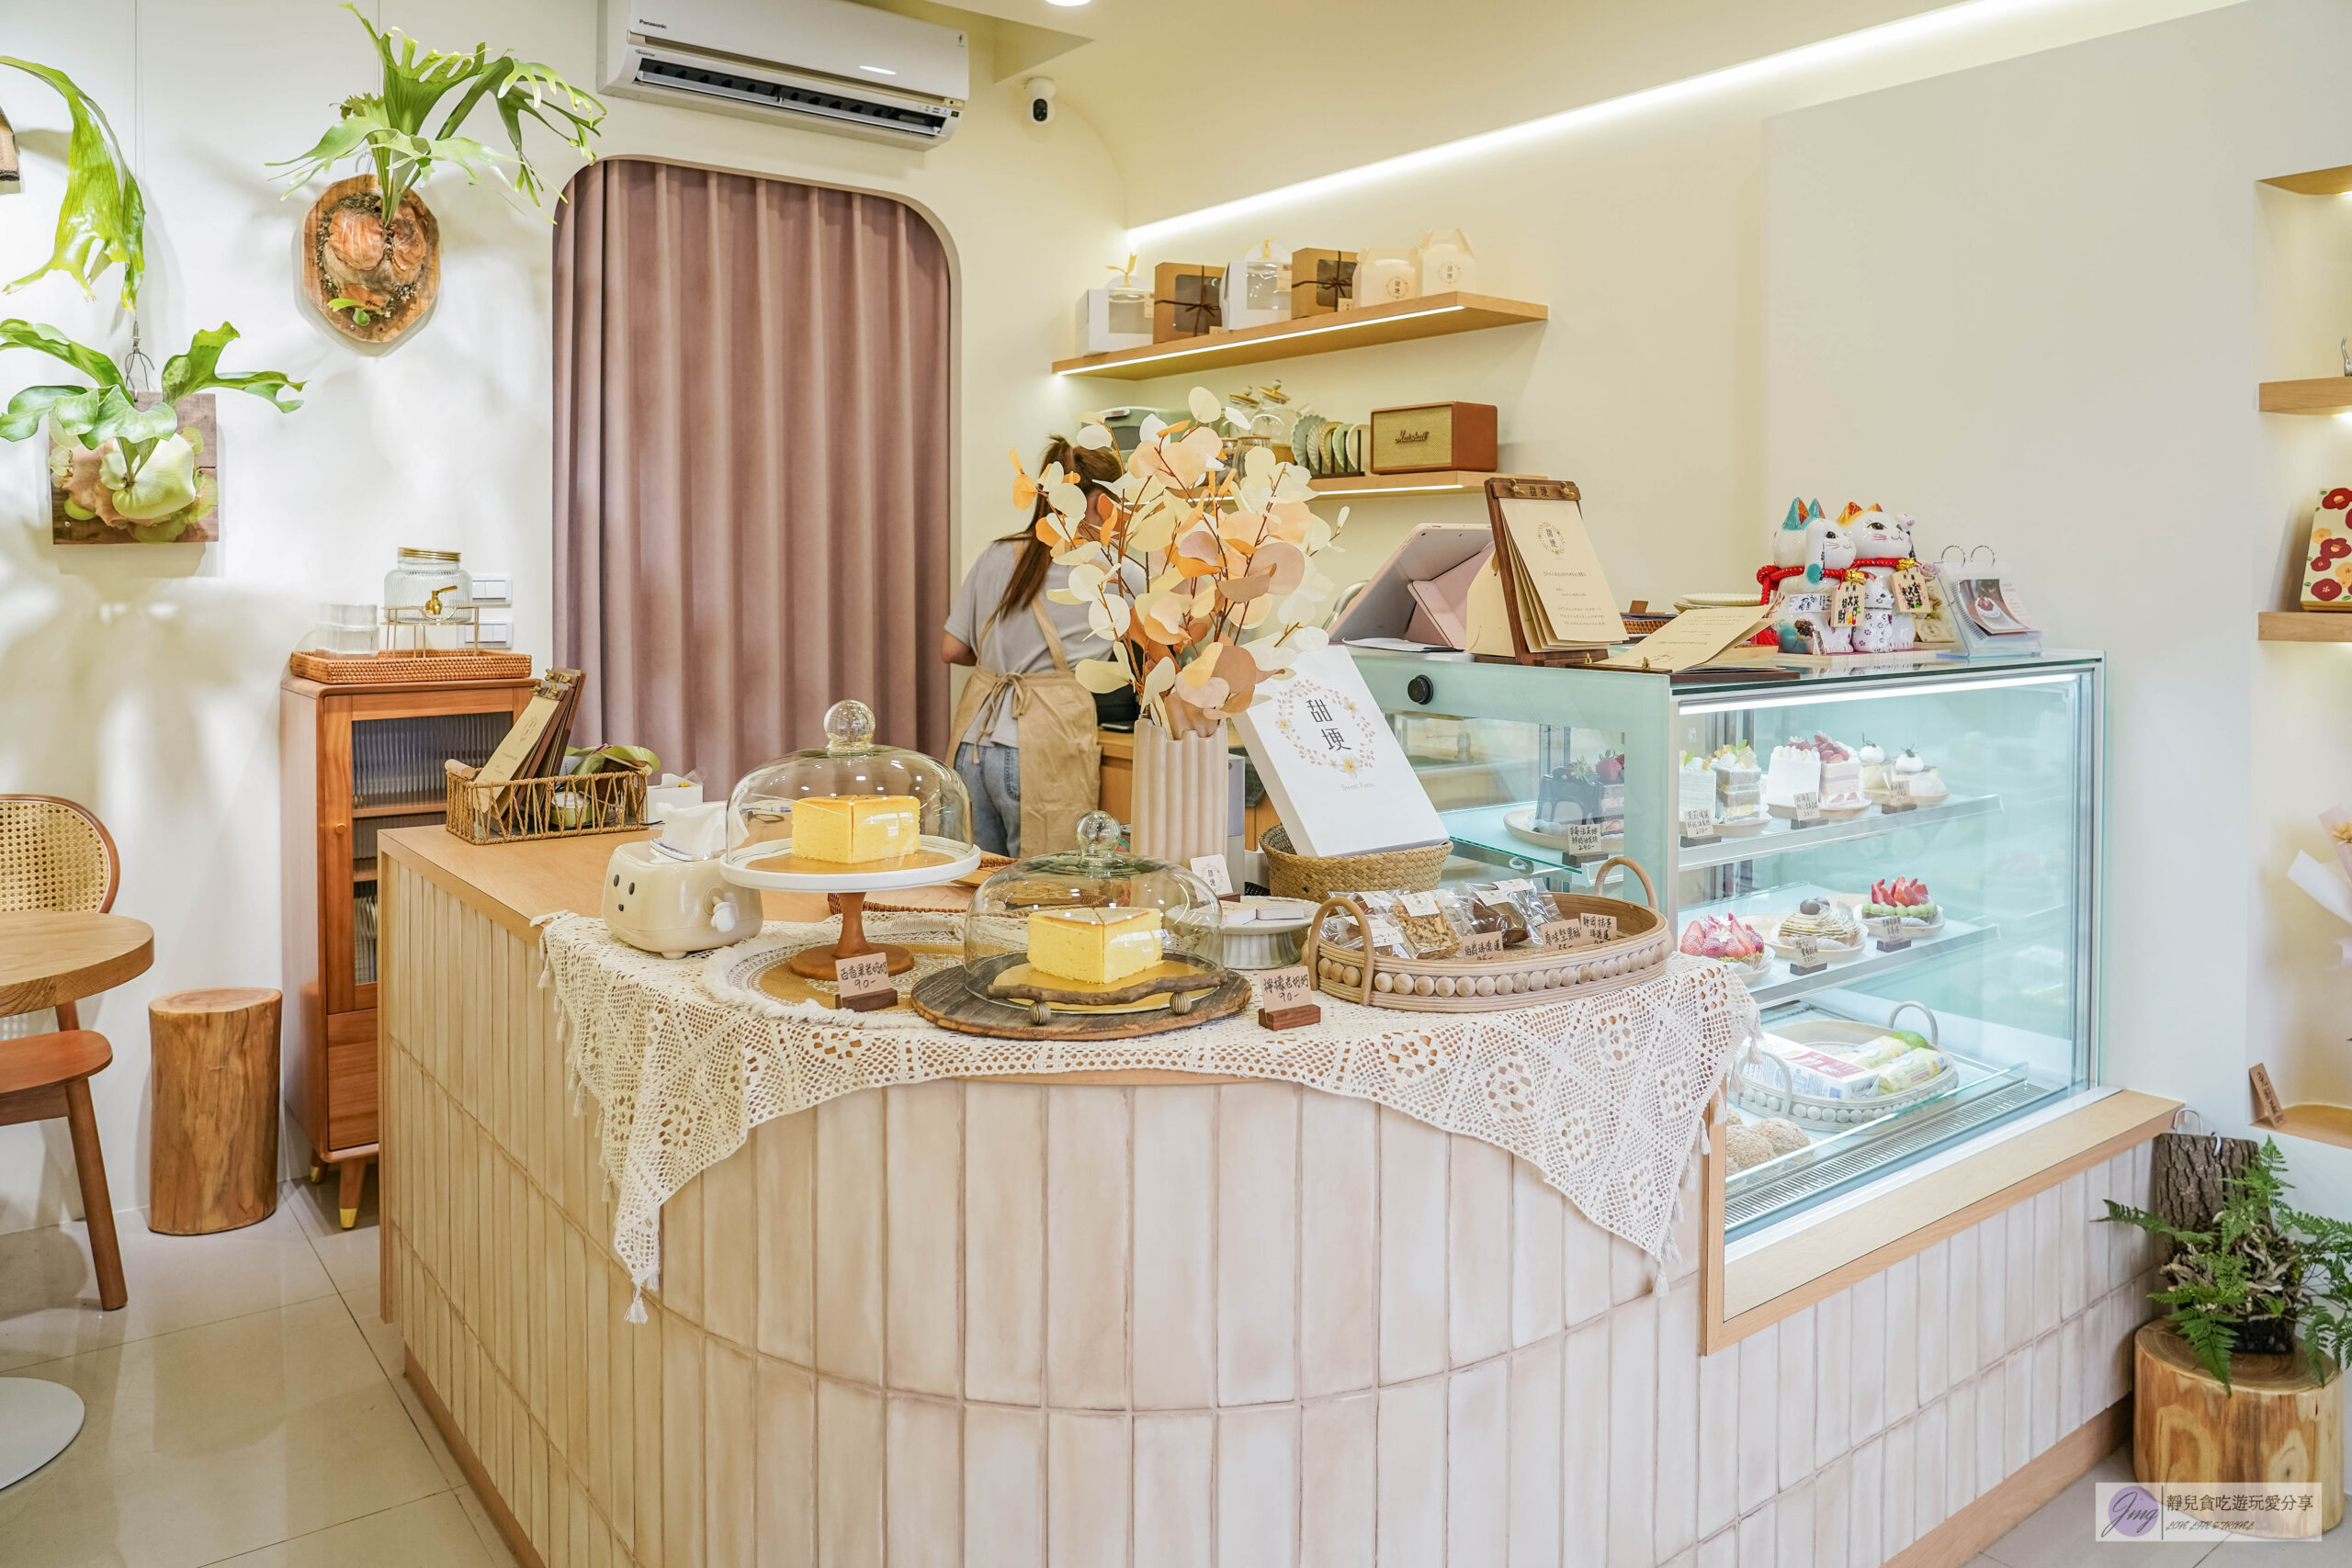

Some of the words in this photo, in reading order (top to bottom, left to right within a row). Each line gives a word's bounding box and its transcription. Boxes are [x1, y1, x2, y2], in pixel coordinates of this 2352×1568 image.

[1395, 430, 1429, 444] Marshall
[1306, 698, 1351, 750] 甜埂
[841, 961, 888, 980] 百香果老奶奶
[1263, 974, 1309, 993] 檸檬老奶奶
